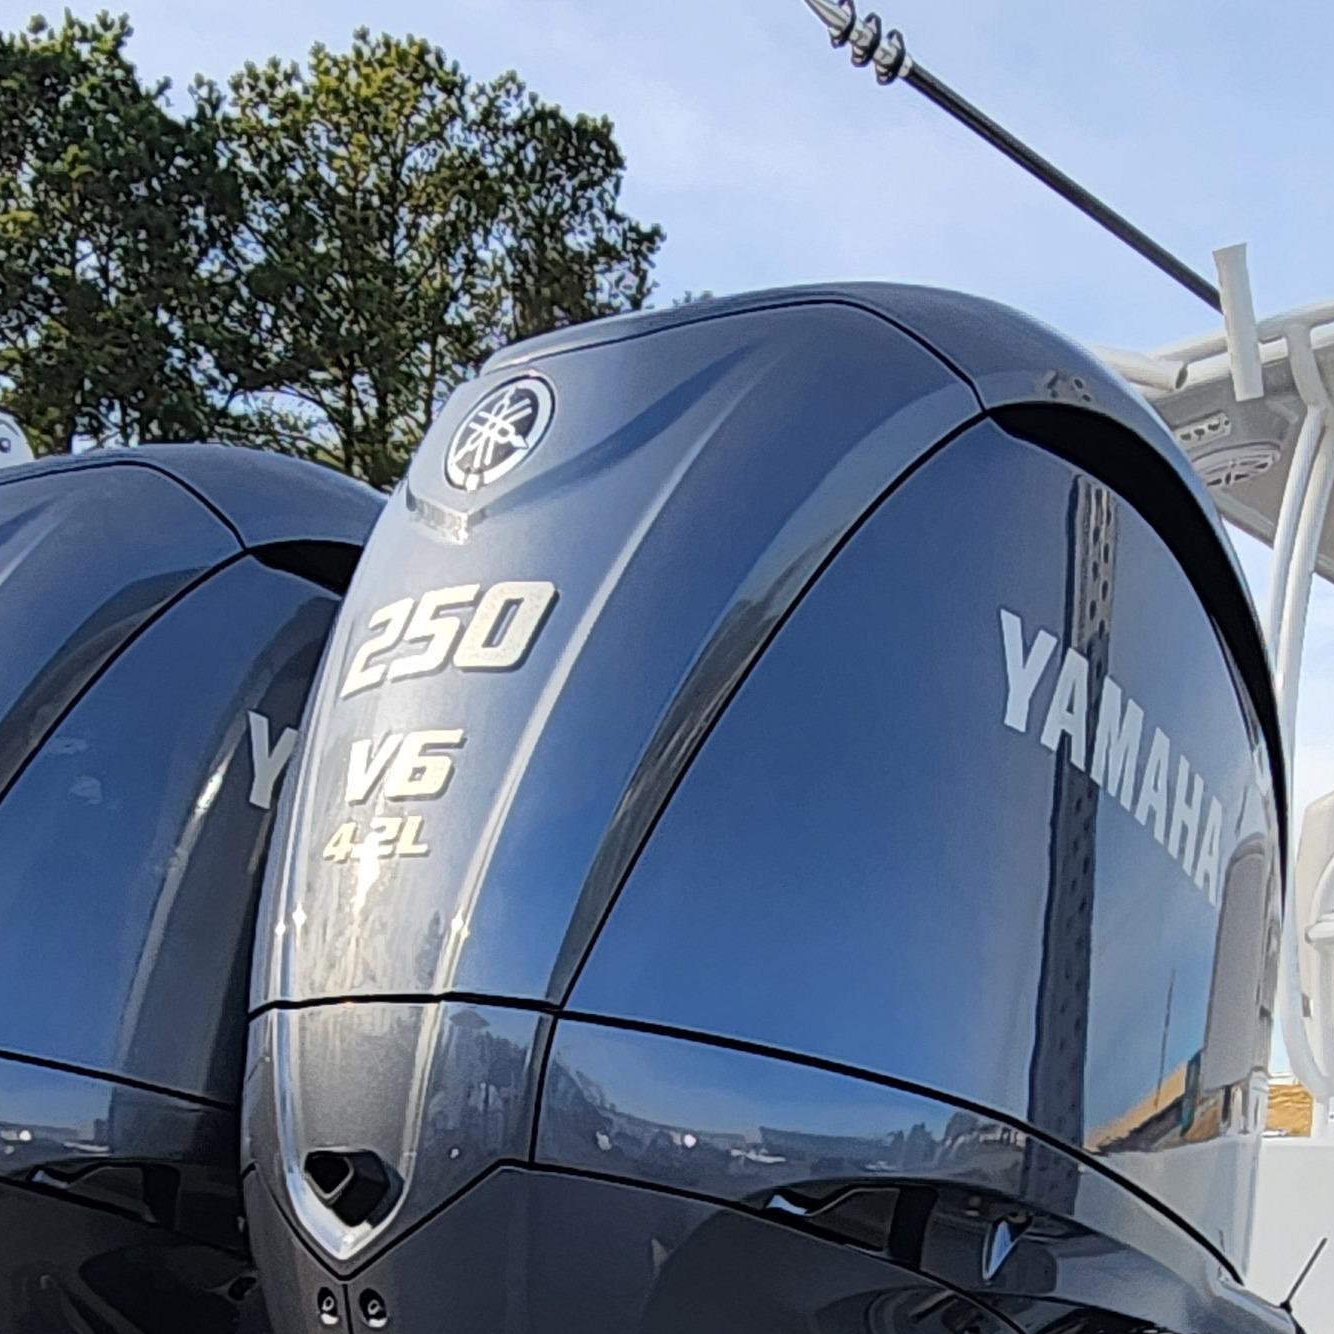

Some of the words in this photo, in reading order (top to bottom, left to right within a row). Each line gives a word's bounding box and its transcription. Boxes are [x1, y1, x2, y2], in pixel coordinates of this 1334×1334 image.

[339, 580, 560, 698] 250
[346, 728, 467, 805] V6
[999, 607, 1223, 908] YAMAHA
